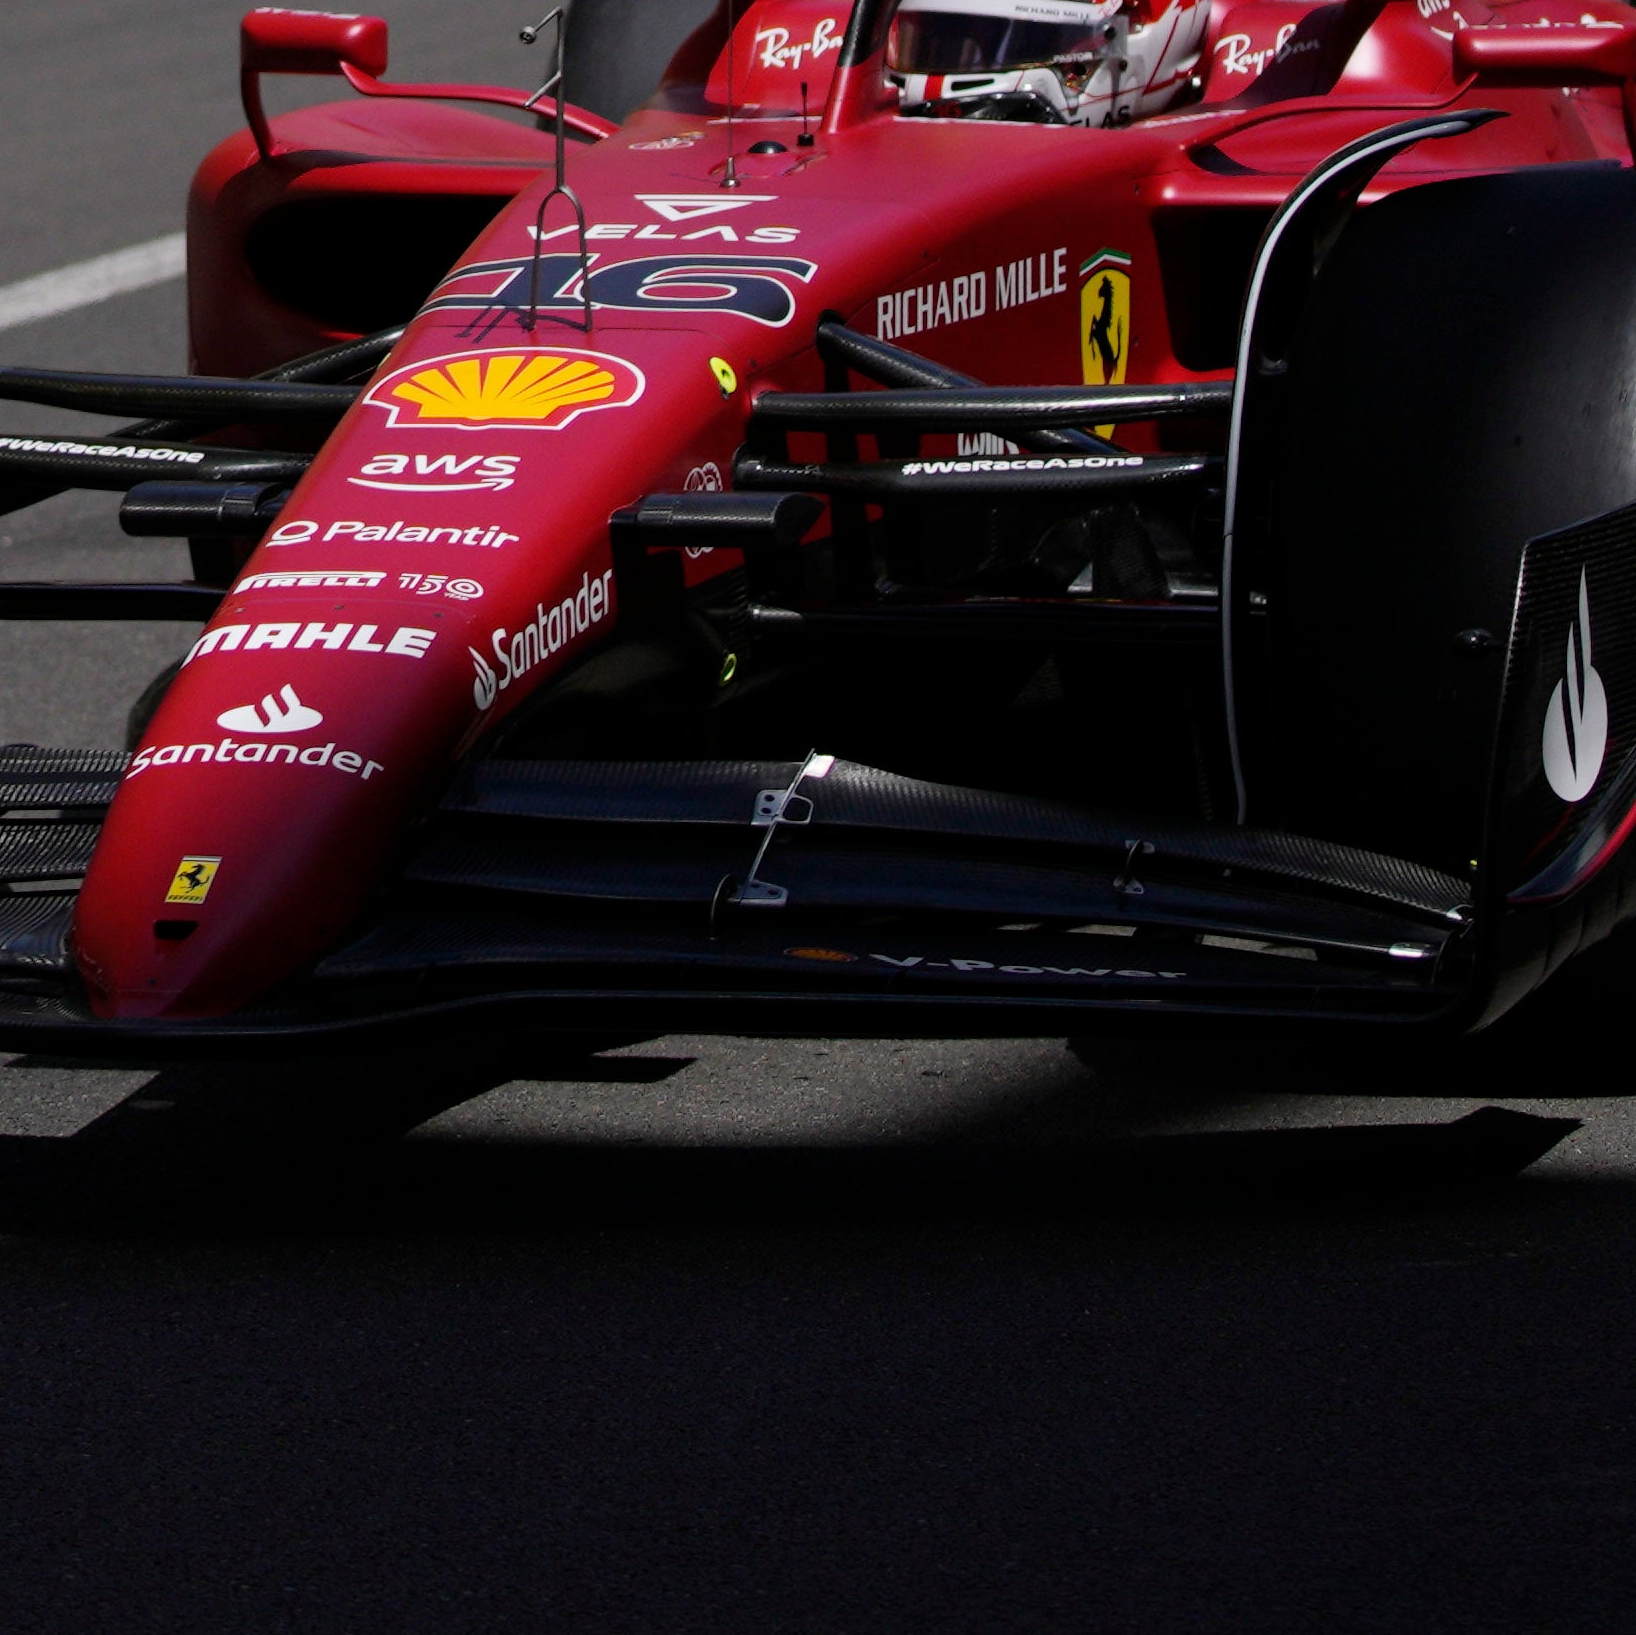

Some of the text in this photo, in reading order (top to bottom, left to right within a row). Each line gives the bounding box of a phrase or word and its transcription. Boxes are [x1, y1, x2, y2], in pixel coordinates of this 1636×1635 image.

[755, 18, 844, 70] Ray-Ba
[1213, 23, 1321, 76] Ray-Ban
[526, 223, 802, 244] VELAS
[413, 253, 818, 328] 16
[876, 247, 1068, 342] RICHARD MILLE
[360, 453, 522, 477] aws
[900, 456, 1144, 476] #WeRaceAsOne
[321, 520, 520, 548] Palantir
[232, 570, 485, 600] PIRELLI 150
[180, 622, 437, 669] MAHLE
[493, 568, 613, 690] Santander
[126, 737, 385, 781] Santander
[867, 953, 1187, 978] V-Power
